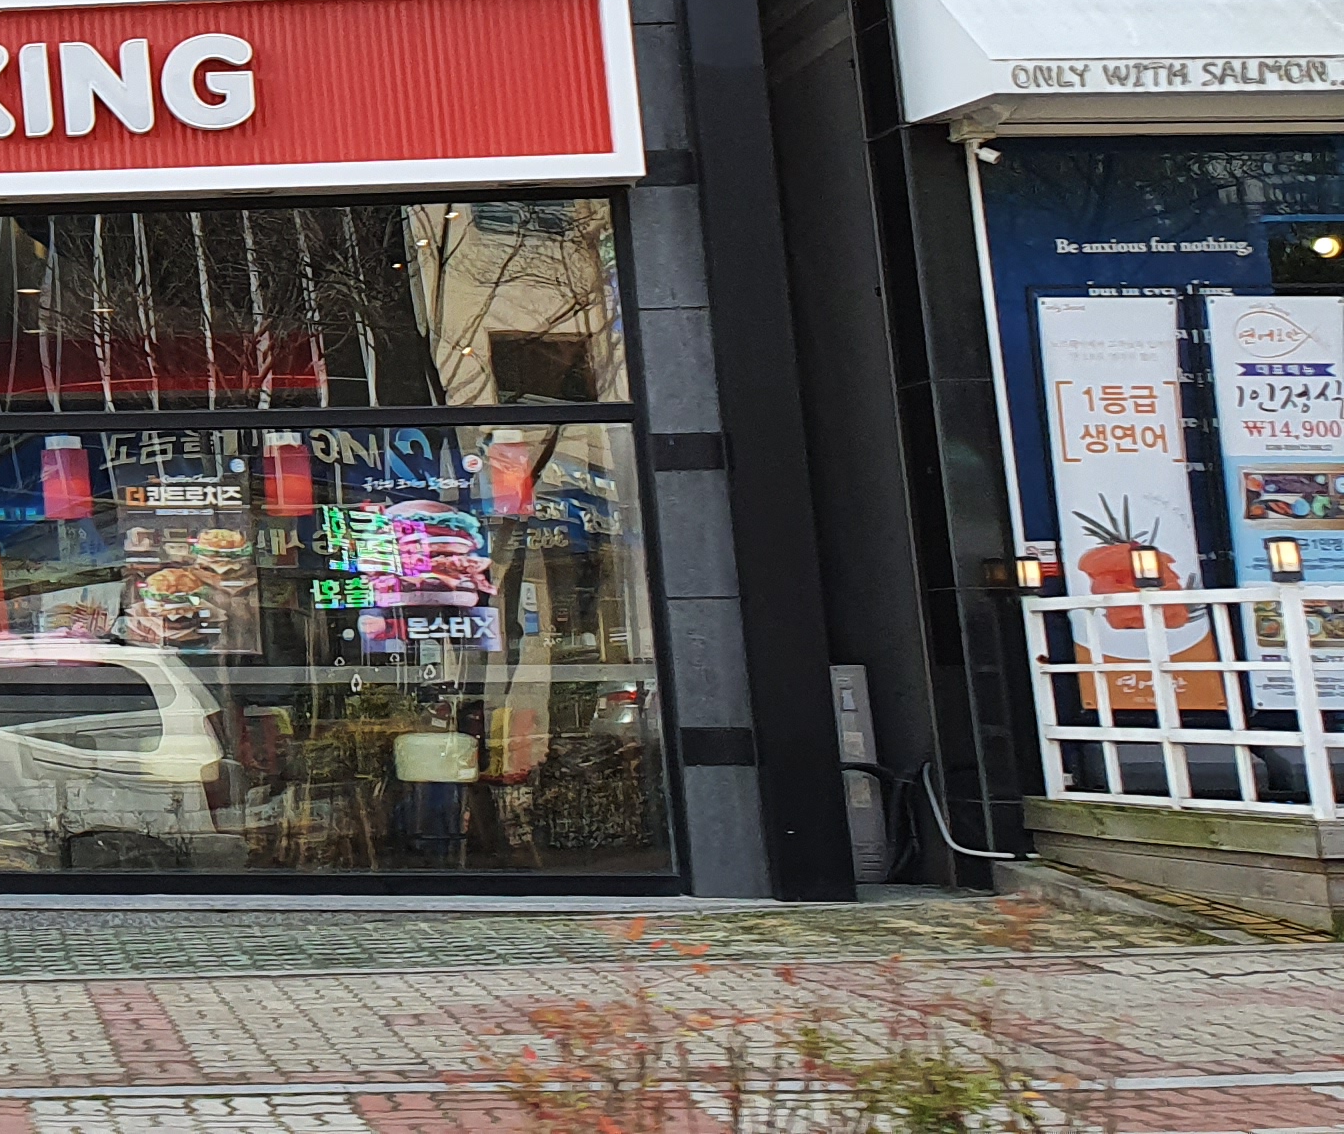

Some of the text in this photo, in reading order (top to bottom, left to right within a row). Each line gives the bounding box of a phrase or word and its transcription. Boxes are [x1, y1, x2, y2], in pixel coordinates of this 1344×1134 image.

[1011, 63, 1091, 89] ONLY
[1103, 62, 1191, 88] WITH
[1055, 238, 1079, 254] Be
[1082, 238, 1147, 254] anxious
[1150, 237, 1177, 253] for
[1082, 385, 1158, 414] 1등급
[1080, 423, 1168, 454] 생연어
[408, 616, 497, 638] 몬스터X
